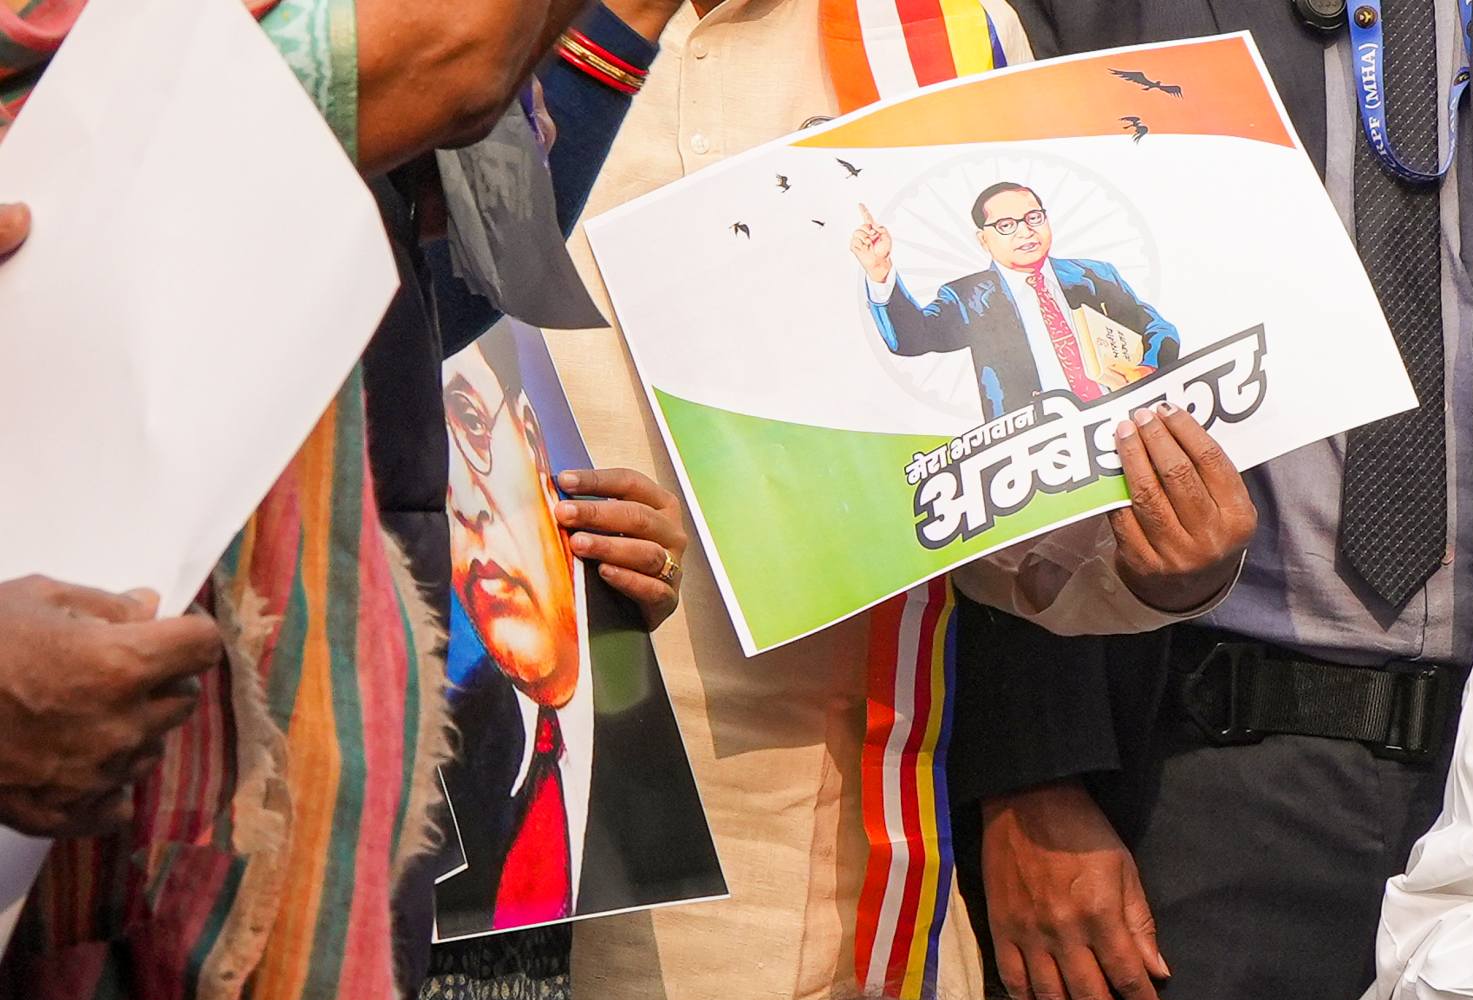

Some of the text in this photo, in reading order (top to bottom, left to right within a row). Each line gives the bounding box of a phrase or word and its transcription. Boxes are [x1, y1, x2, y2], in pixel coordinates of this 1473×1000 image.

[1358, 43, 1381, 109] (MHA)
[905, 405, 1036, 484] मेरा भगवान
